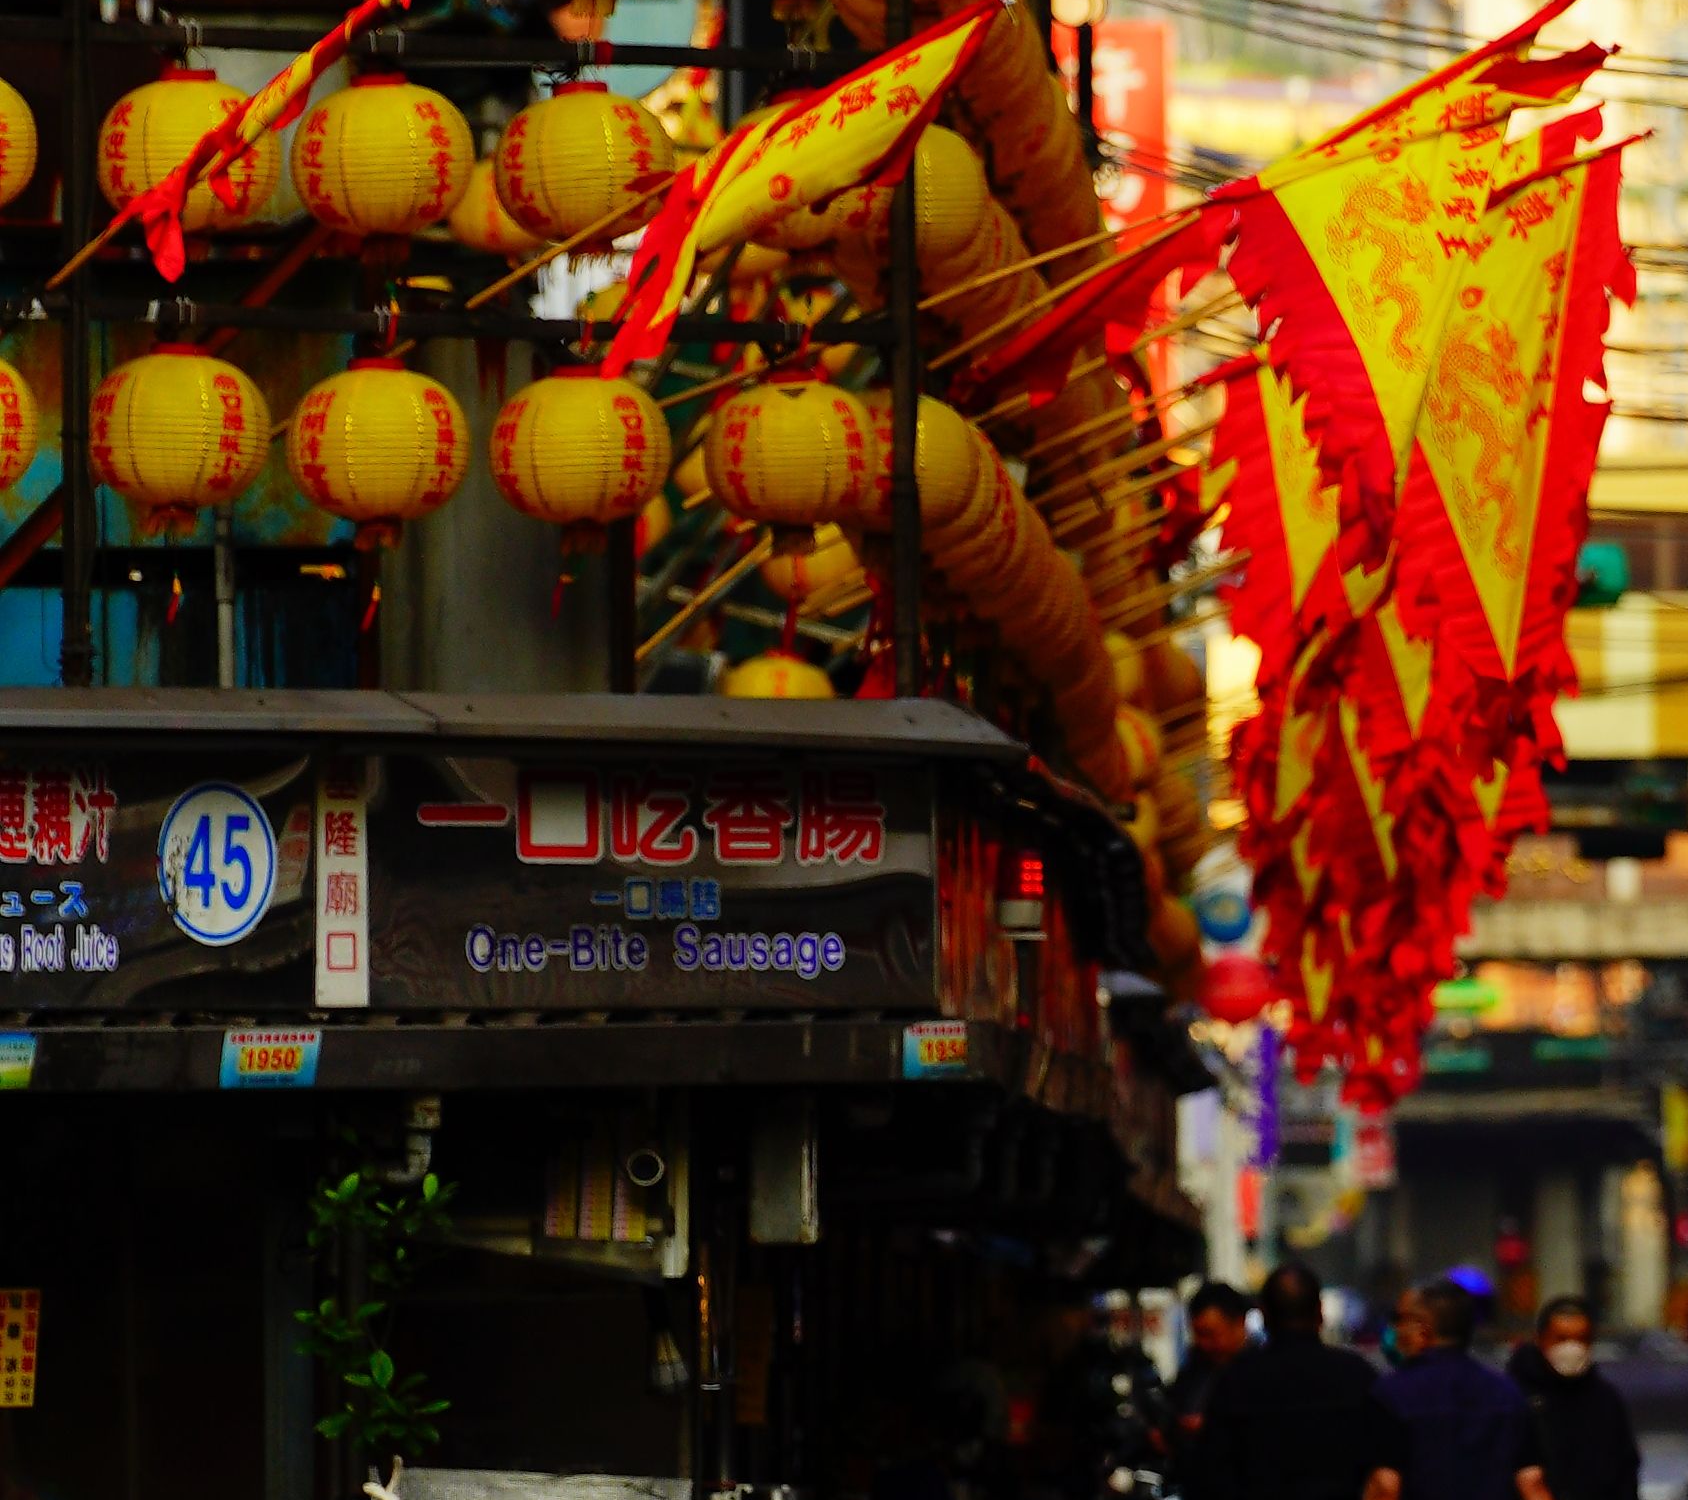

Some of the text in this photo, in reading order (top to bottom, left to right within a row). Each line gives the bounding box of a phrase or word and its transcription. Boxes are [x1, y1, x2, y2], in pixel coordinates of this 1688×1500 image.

[417, 767, 887, 867] 一口吃香腸
[182, 813, 253, 911] 45
[20, 923, 65, 973] Root
[70, 923, 119, 973] Juice
[466, 923, 847, 981] One-Bite Sausage
[245, 1047, 298, 1071] 1950
